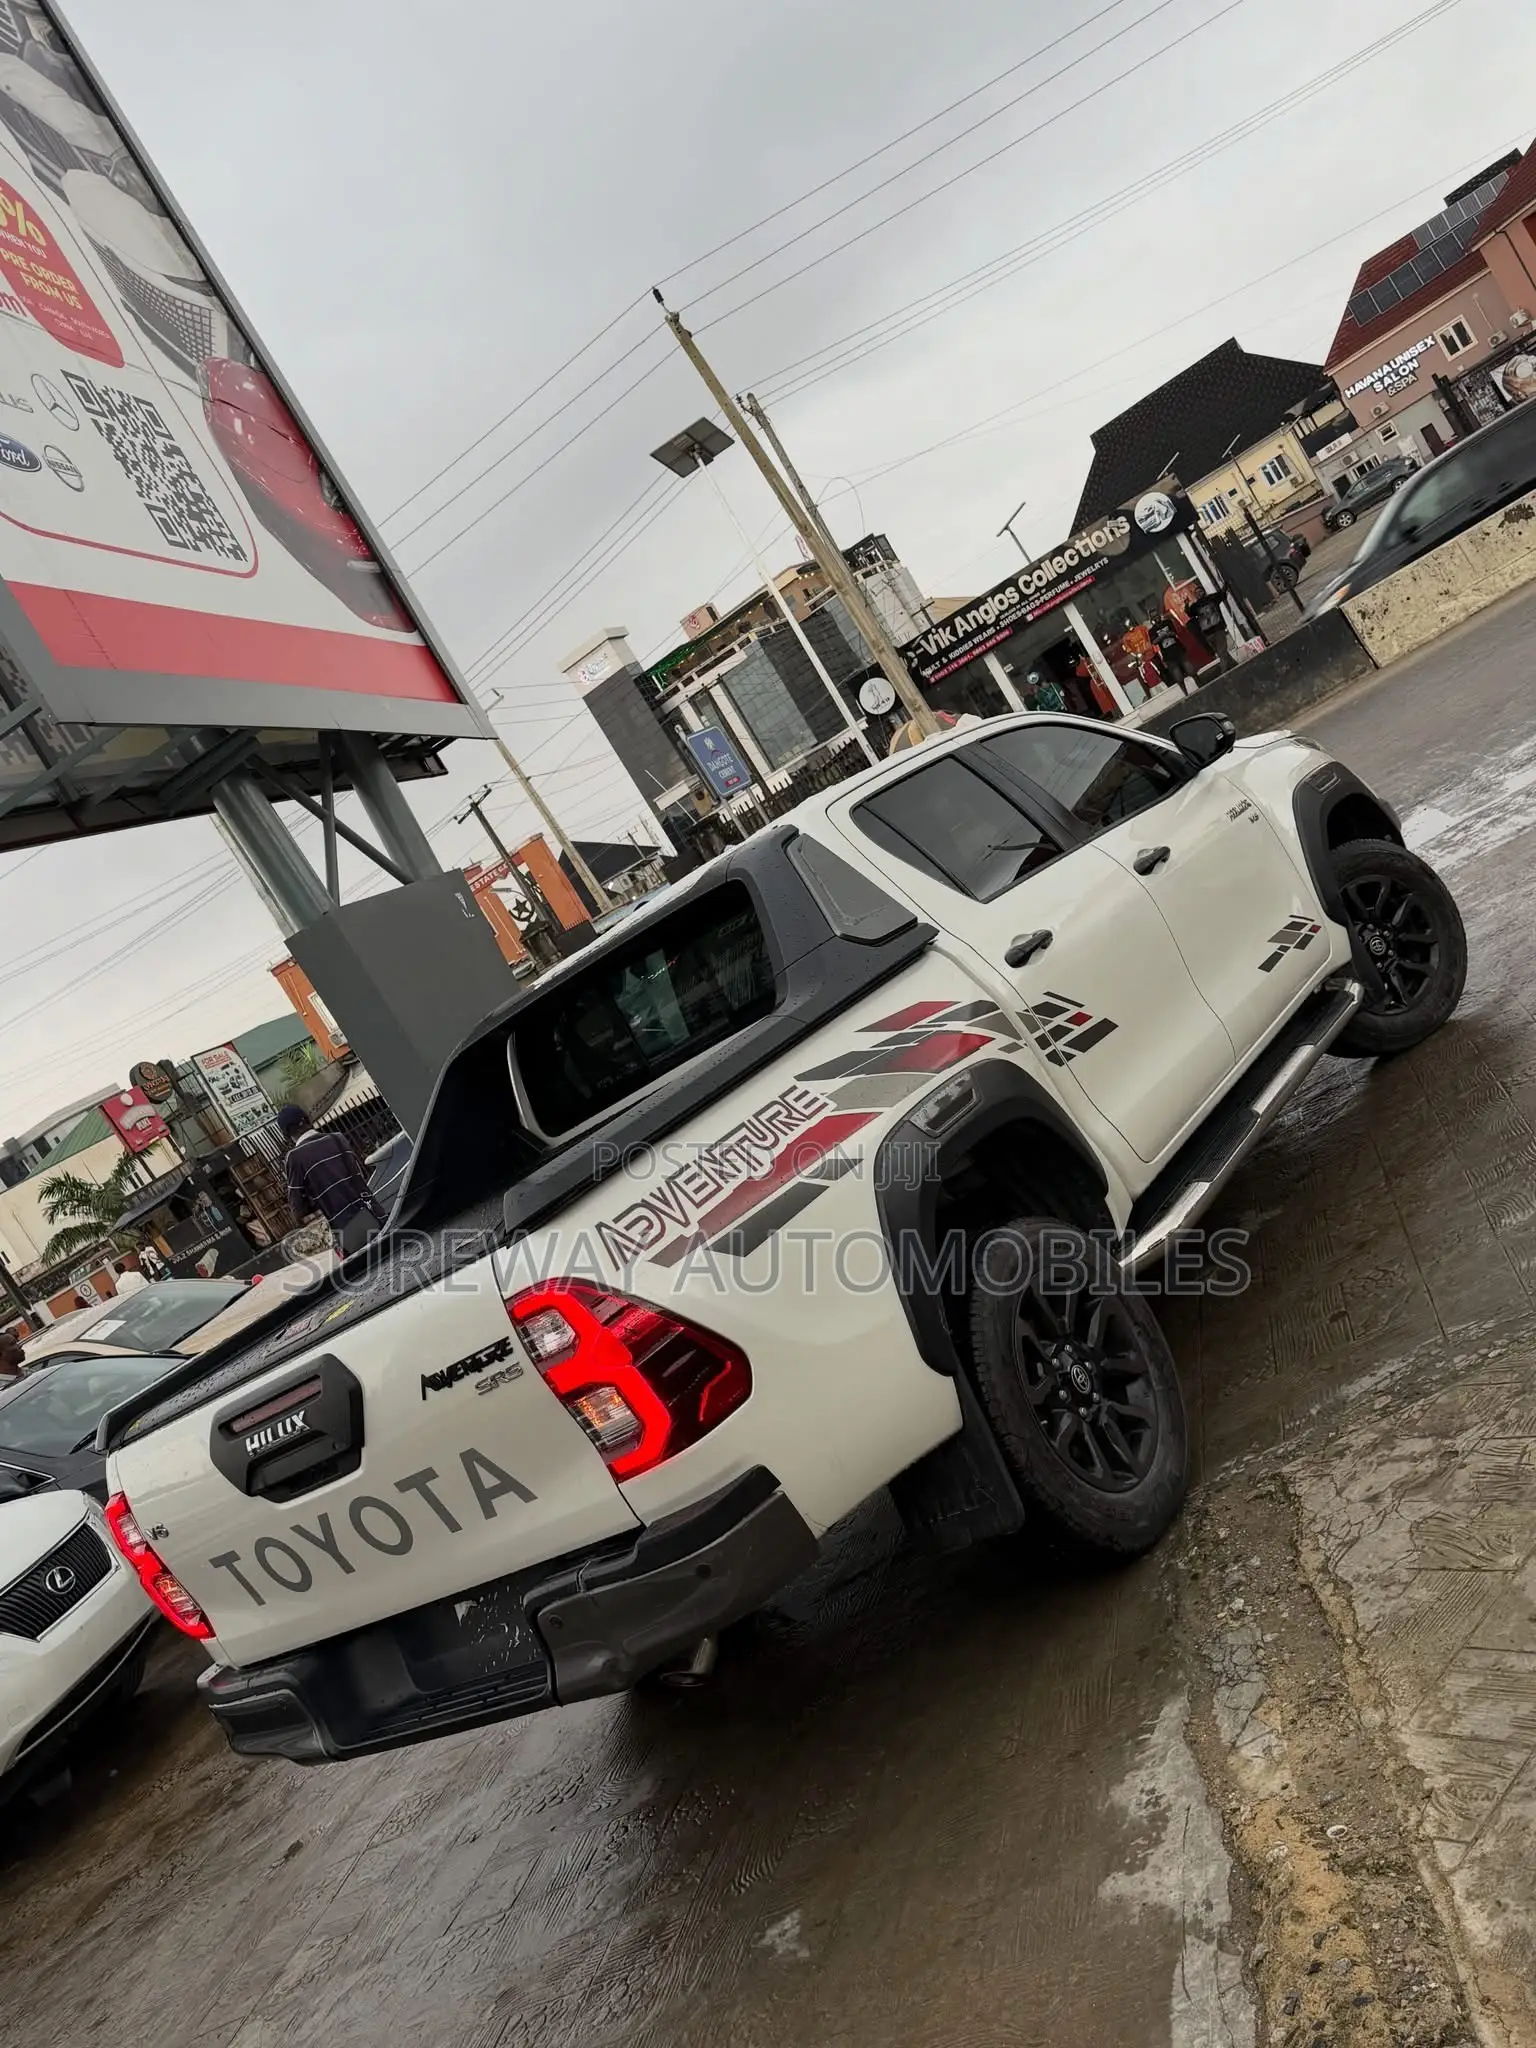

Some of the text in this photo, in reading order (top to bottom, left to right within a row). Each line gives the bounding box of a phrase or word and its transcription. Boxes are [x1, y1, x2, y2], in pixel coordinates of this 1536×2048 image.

[20, 271, 62, 301] FROM
[1344, 335, 1436, 399] HAVANA UNISEX
[1372, 358, 1420, 393] SALON
[948, 642, 974, 661] KIDDIES
[973, 626, 996, 645] WEARS
[1074, 556, 1109, 582] JEWELRYS
[954, 587, 1020, 638] Anglos
[1018, 514, 1131, 595] Collections
[594, 1083, 830, 1272] ADVENTURE
[245, 1410, 312, 1457] HILUX
[208, 1447, 539, 1607] TOYOTA
